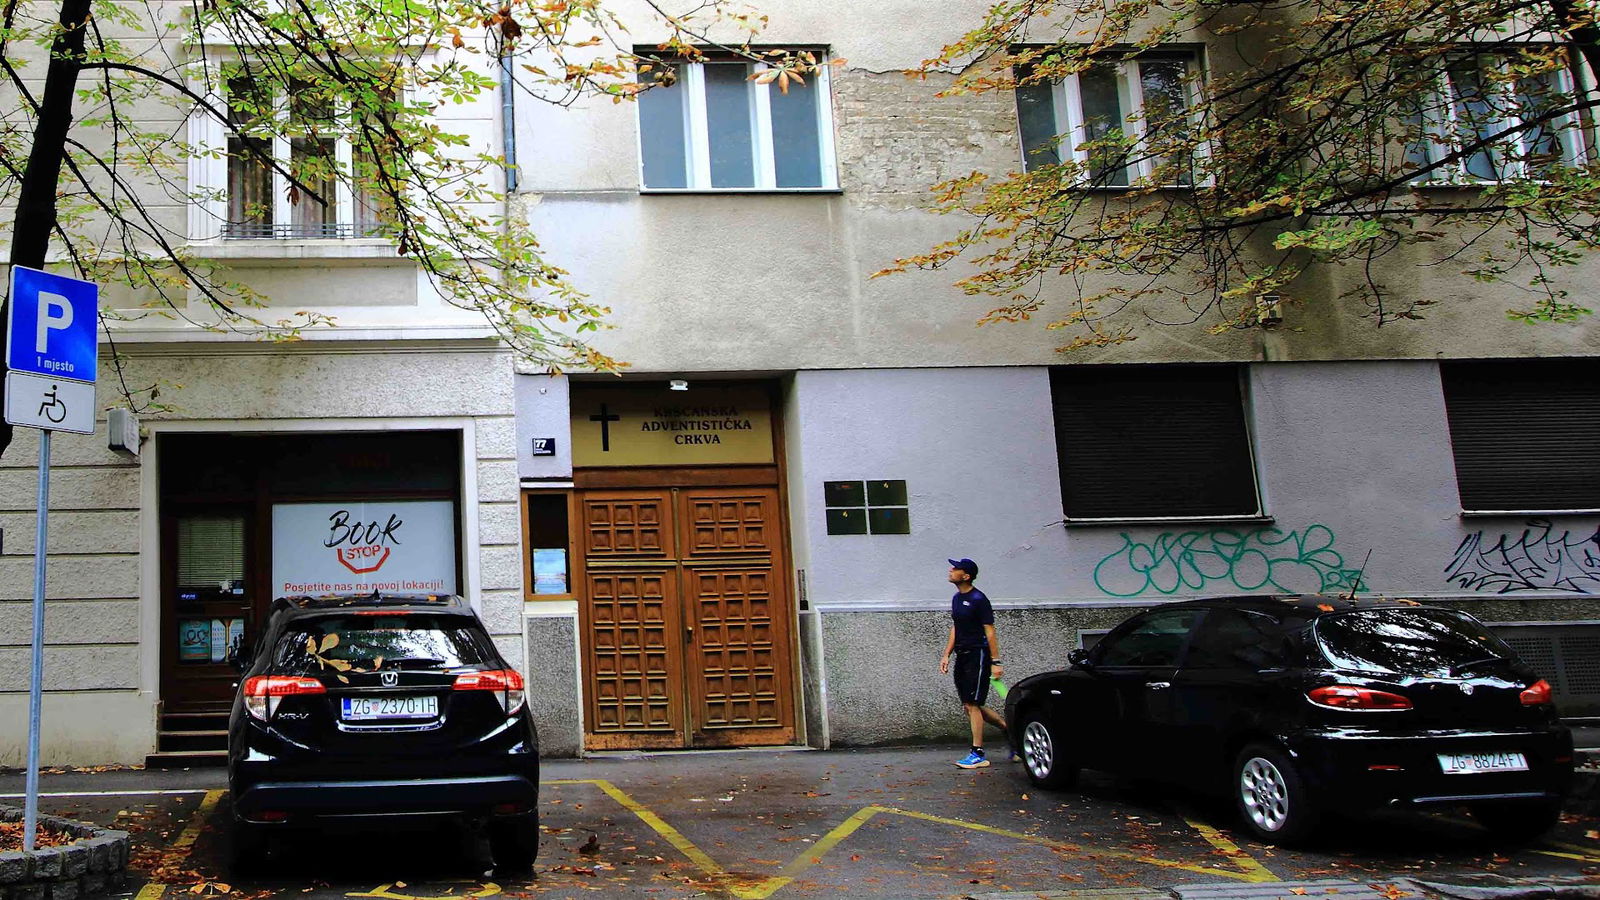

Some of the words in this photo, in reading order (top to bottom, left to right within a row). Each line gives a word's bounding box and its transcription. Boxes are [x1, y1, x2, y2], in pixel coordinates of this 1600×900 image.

[36, 291, 74, 354] P
[36, 356, 42, 368] 1
[44, 358, 75, 373] mjesto
[641, 418, 752, 431] ADVENTISTIČKA
[535, 439, 547, 448] 77
[674, 434, 721, 445] CRKVA
[346, 544, 381, 560] STOP
[284, 581, 331, 593] Posjetite
[334, 583, 353, 591] nas
[355, 583, 369, 591] na
[371, 581, 400, 592] novoj
[402, 579, 444, 591] lokaciji!
[353, 699, 370, 715] ZG
[1448, 754, 1466, 769] ZG
